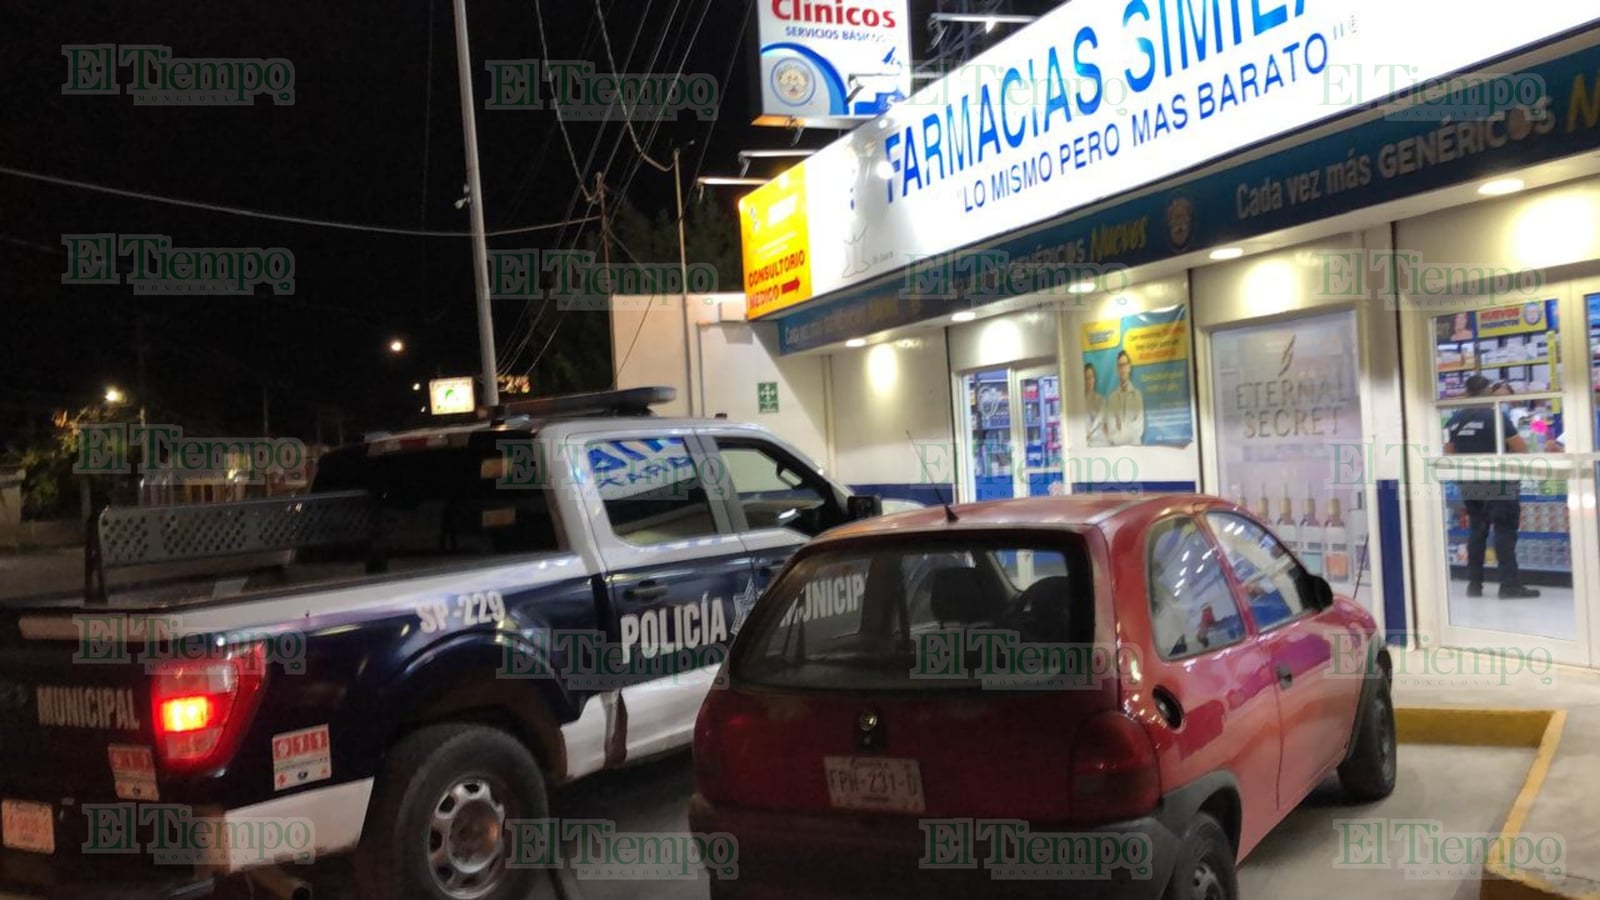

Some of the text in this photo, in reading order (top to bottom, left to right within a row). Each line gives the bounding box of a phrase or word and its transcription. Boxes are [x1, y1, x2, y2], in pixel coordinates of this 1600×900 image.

[785, 26, 839, 39] SERVICIOS
[884, 0, 1304, 203] FARMACIAS SIMI
[992, 152, 1052, 202] MISMO
[1060, 124, 1121, 175] PERO
[1132, 94, 1188, 147] MAS
[1237, 182, 1283, 219] Cada
[1286, 169, 1321, 204] vez
[1326, 149, 1372, 196] más
[748, 249, 805, 287] CONSULTORIO
[1236, 377, 1352, 411] ETERNAL
[1243, 405, 1342, 439] SECRET
[620, 591, 727, 665] POLICÍA
[36, 685, 140, 731] MUNICIPAL
